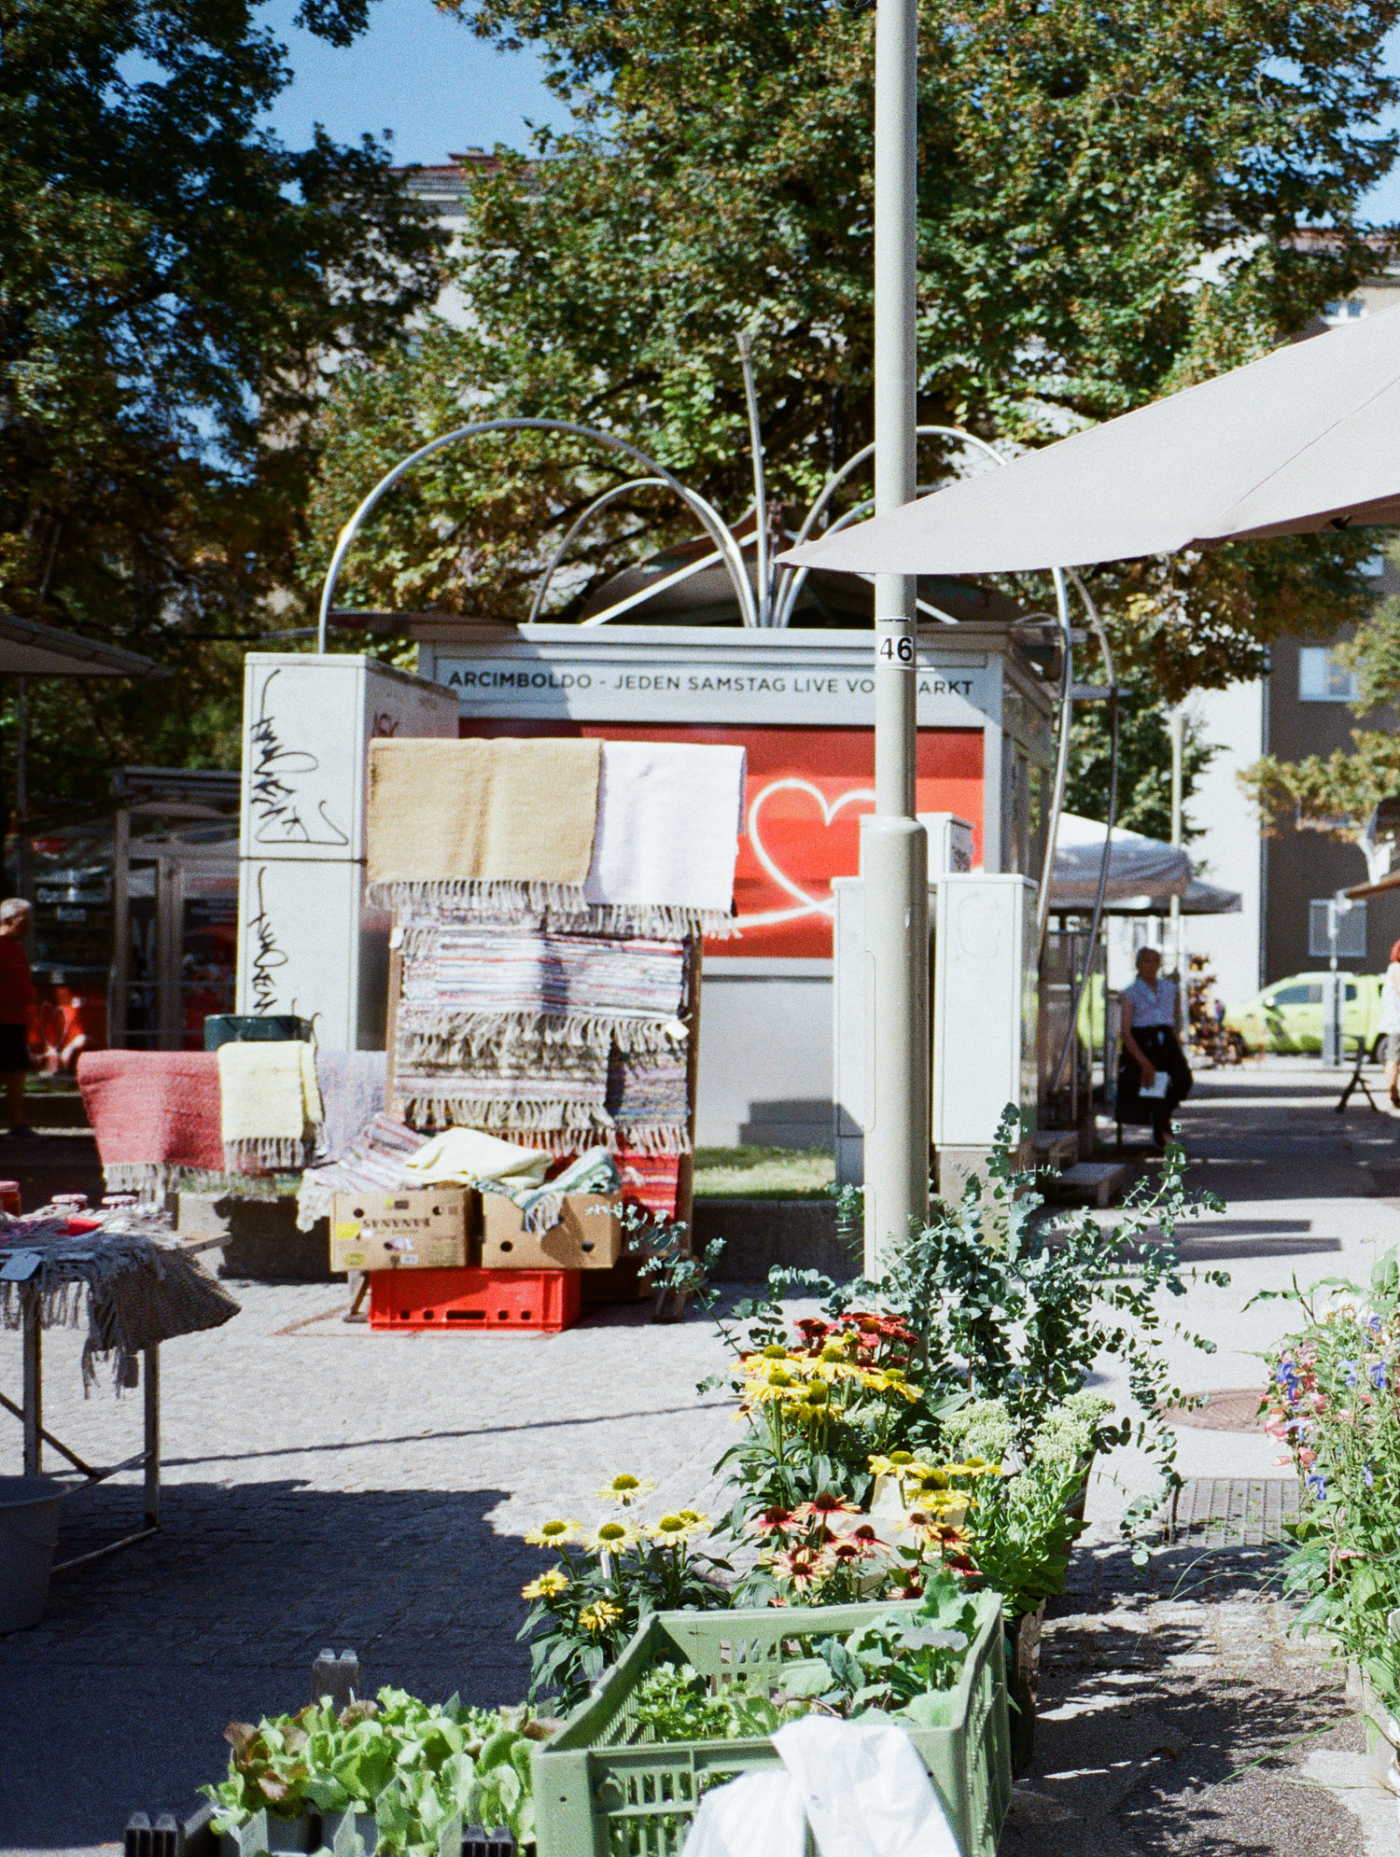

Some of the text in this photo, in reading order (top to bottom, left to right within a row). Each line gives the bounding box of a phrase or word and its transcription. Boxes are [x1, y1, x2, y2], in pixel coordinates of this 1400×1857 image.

[880, 637, 913, 662] 46
[448, 671, 592, 689] ARCIMBOLDO
[614, 674, 681, 690] JEDEN
[688, 676, 786, 692] SAMSTAG
[794, 678, 838, 693] LIVE
[846, 679, 875, 693] VO
[918, 680, 974, 696] ARKT
